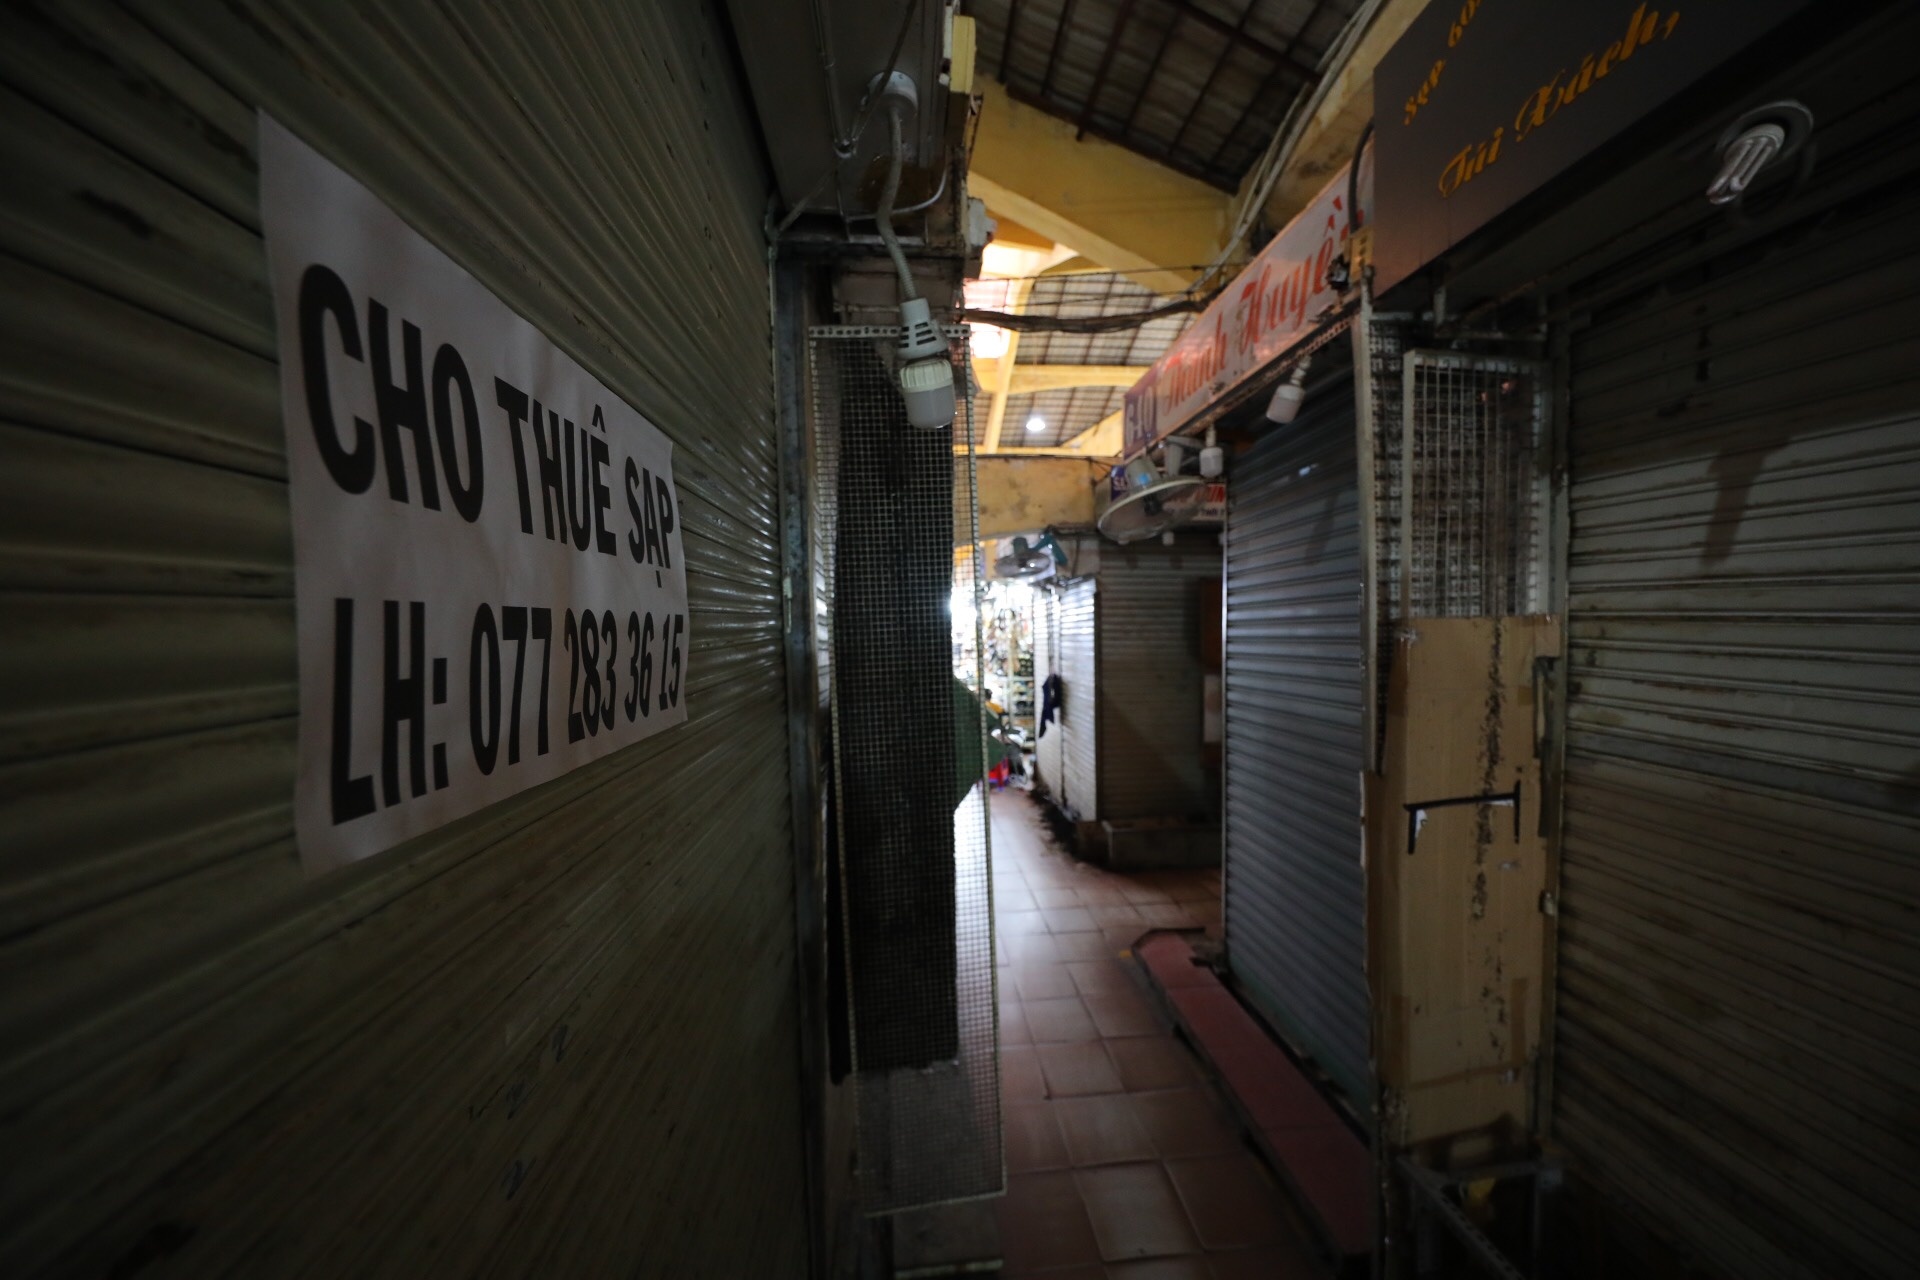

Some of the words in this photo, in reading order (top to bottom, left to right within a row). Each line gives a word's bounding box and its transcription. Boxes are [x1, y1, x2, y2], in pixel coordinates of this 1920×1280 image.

[1239, 195, 1364, 357] Huyề
[297, 263, 485, 524] CHO
[493, 375, 618, 557] THUÊ
[624, 455, 675, 588] SẠP
[330, 597, 449, 826] LH:
[469, 602, 553, 776] 077
[564, 607, 618, 745] 283
[624, 610, 655, 723] 36
[658, 612, 685, 709] 15
